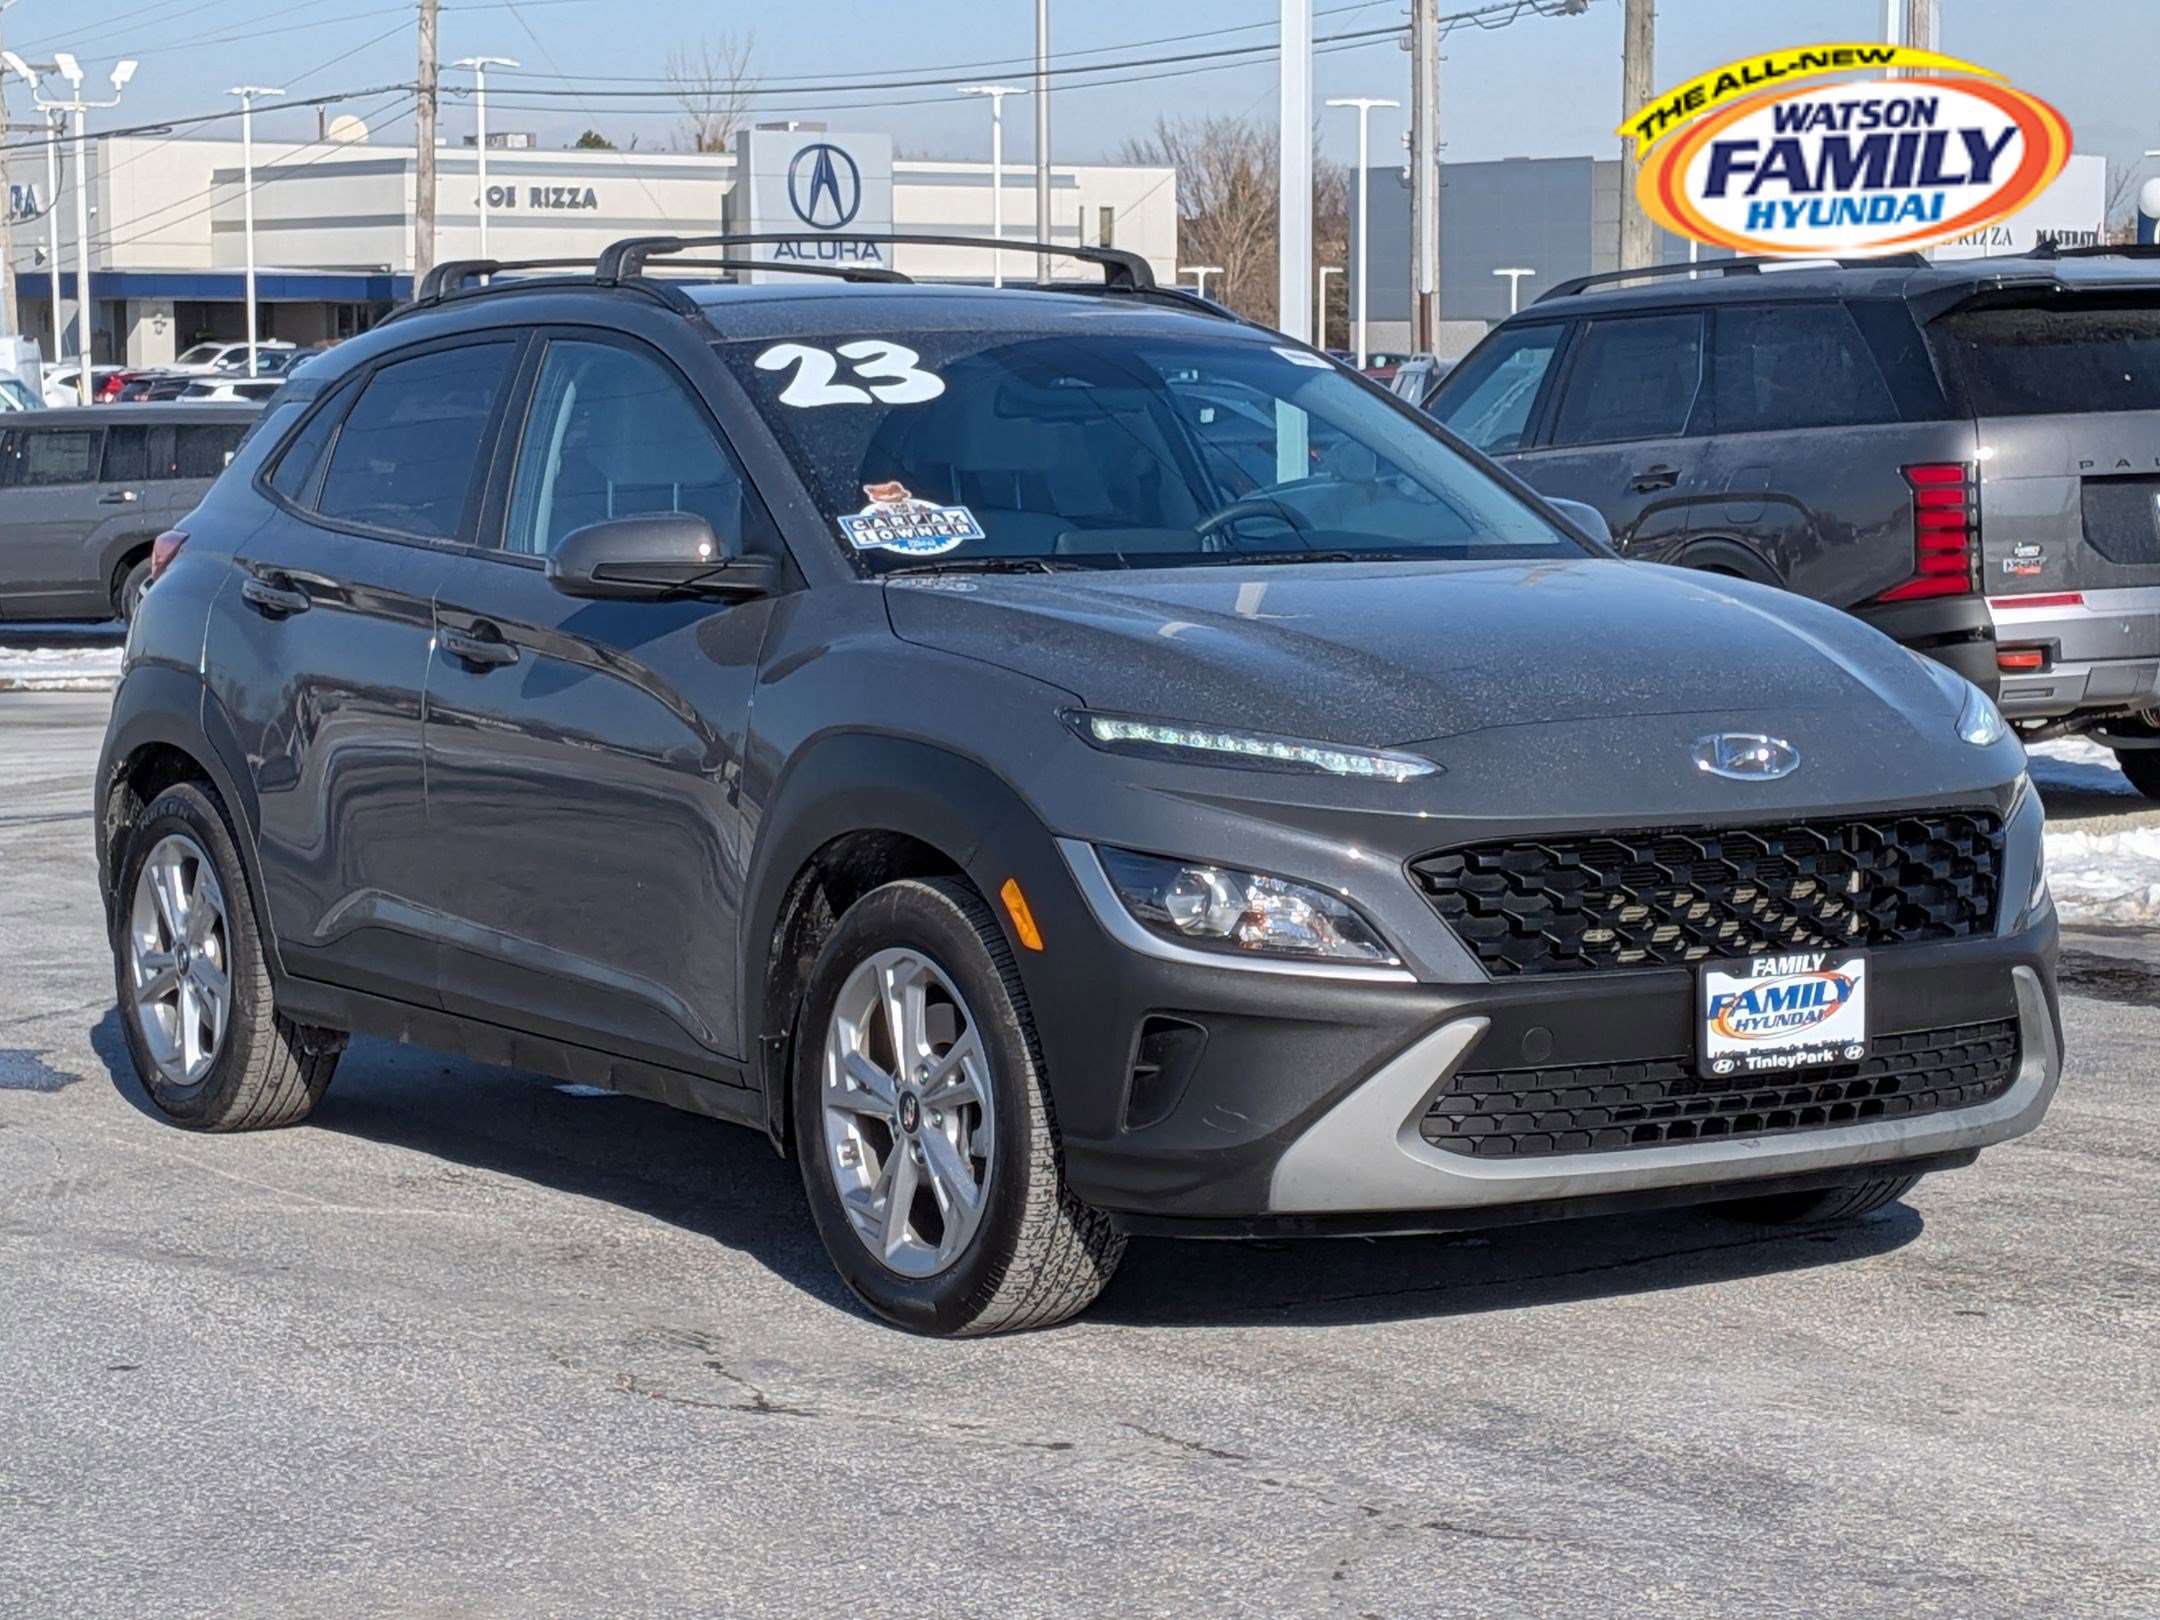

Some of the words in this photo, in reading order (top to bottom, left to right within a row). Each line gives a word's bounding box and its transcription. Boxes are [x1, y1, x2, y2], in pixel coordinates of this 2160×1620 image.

[473, 186, 516, 208] OE
[529, 186, 598, 209] RIZZA
[773, 241, 882, 261] ACURA
[755, 340, 945, 407] 23
[852, 510, 969, 531] CARFAX
[879, 523, 971, 541] OWNER
[1752, 953, 1825, 977] FAMILY
[1707, 976, 1862, 1020] FAMILY
[1734, 1009, 1825, 1032] HYUNDAI
